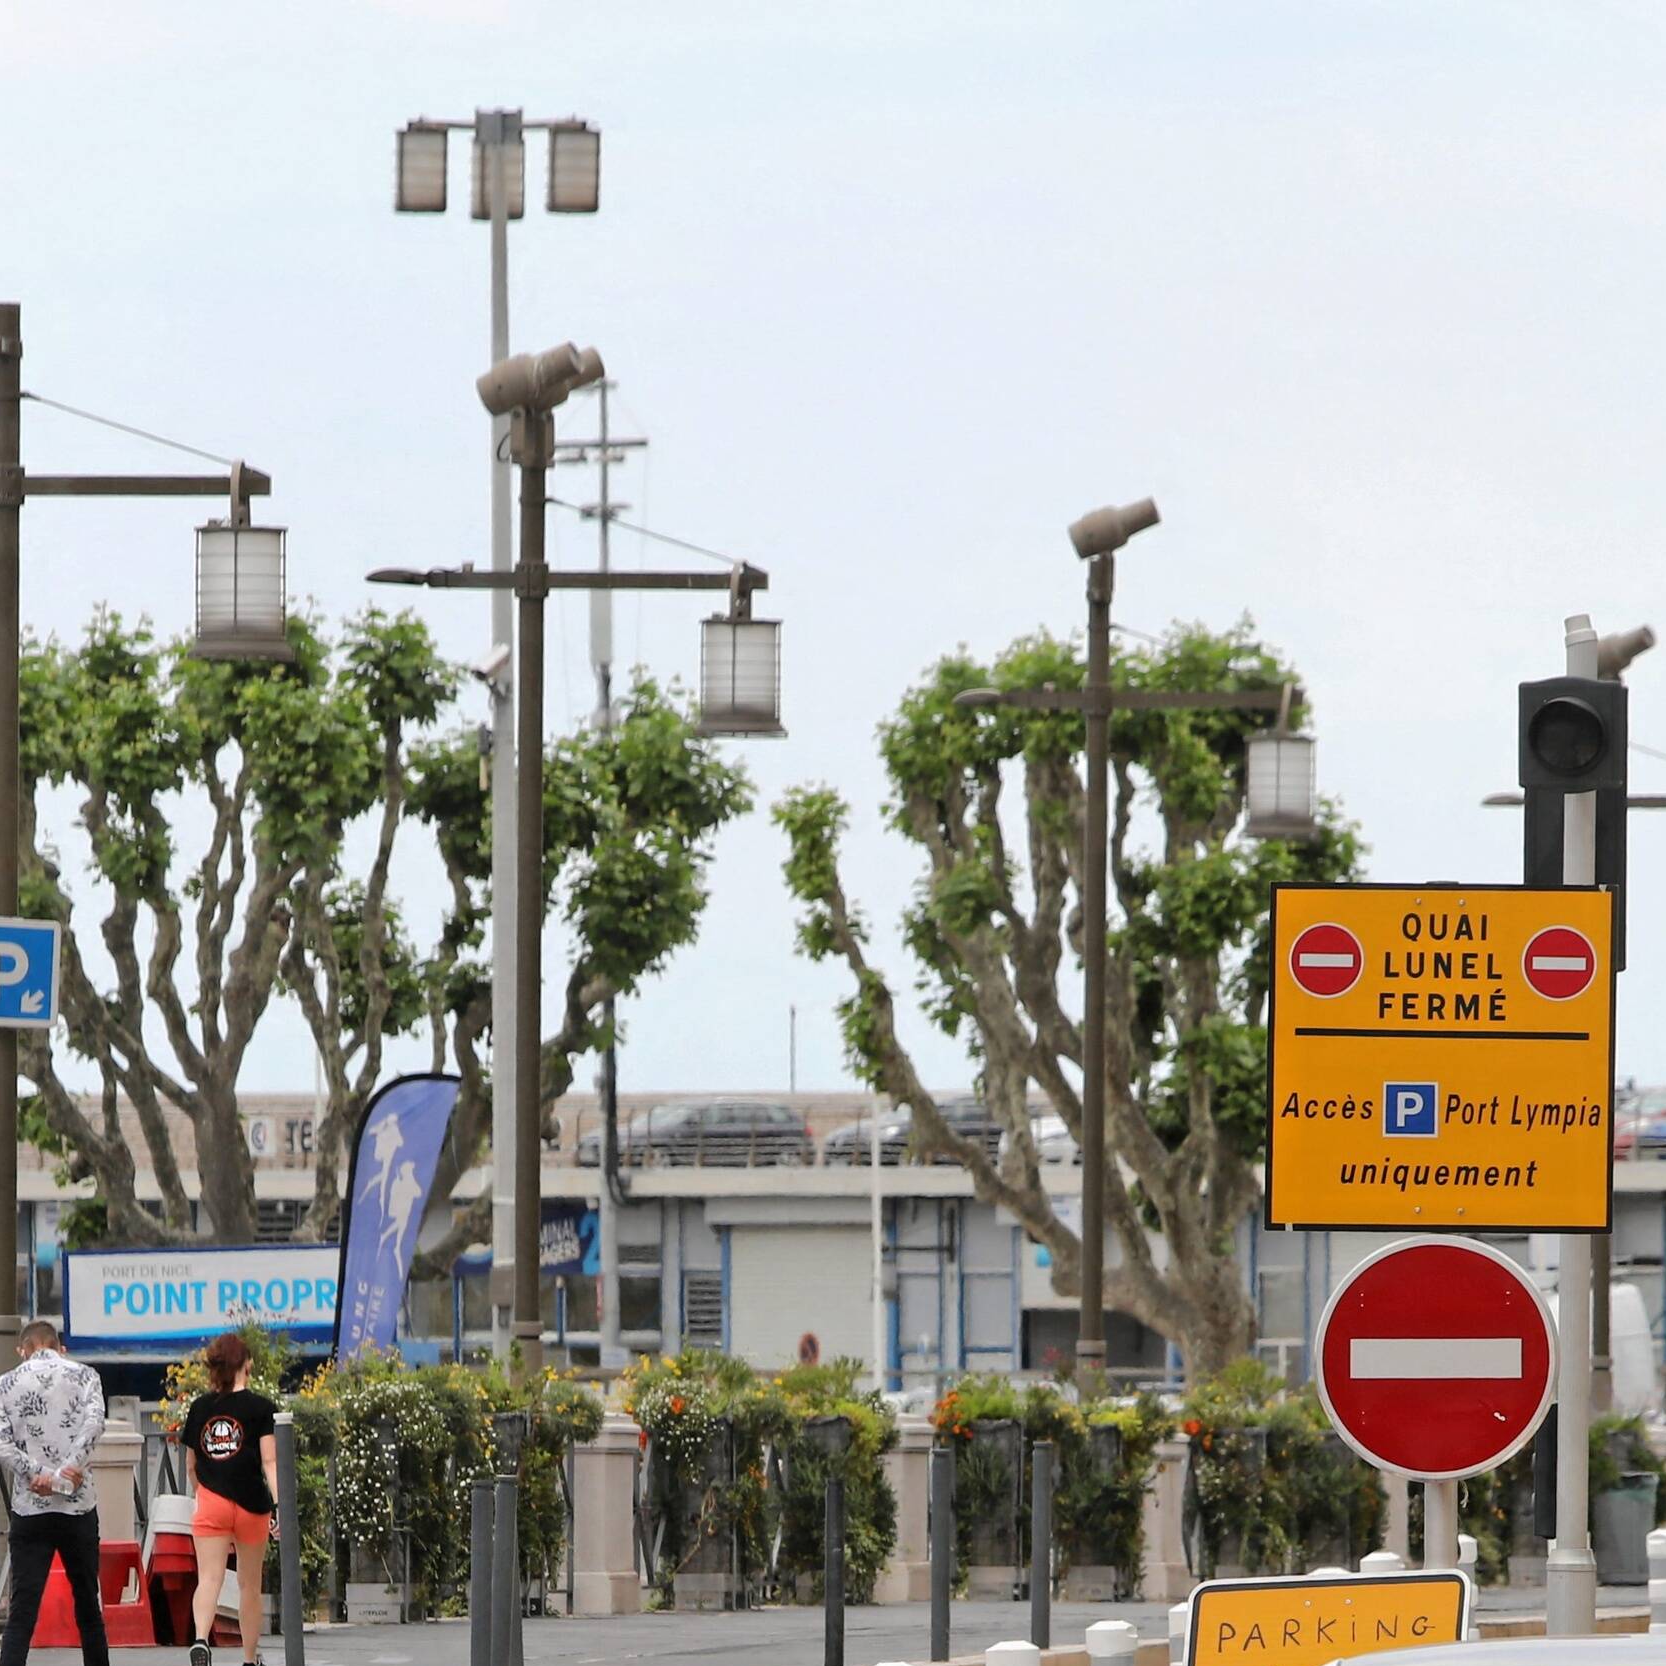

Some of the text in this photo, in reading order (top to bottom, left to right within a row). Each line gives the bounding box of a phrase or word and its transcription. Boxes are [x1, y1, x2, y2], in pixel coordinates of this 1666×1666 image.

[1402, 912, 1488, 942] QUAI
[1384, 952, 1502, 980] LUNEL
[1379, 989, 1507, 1022] FERMÉ
[1281, 1091, 1601, 1134] Accès P Port Lympia
[1340, 1157, 1538, 1192] uniquement
[102, 1263, 192, 1279] PORT DE NICE
[102, 1278, 339, 1317] POINT PROPR
